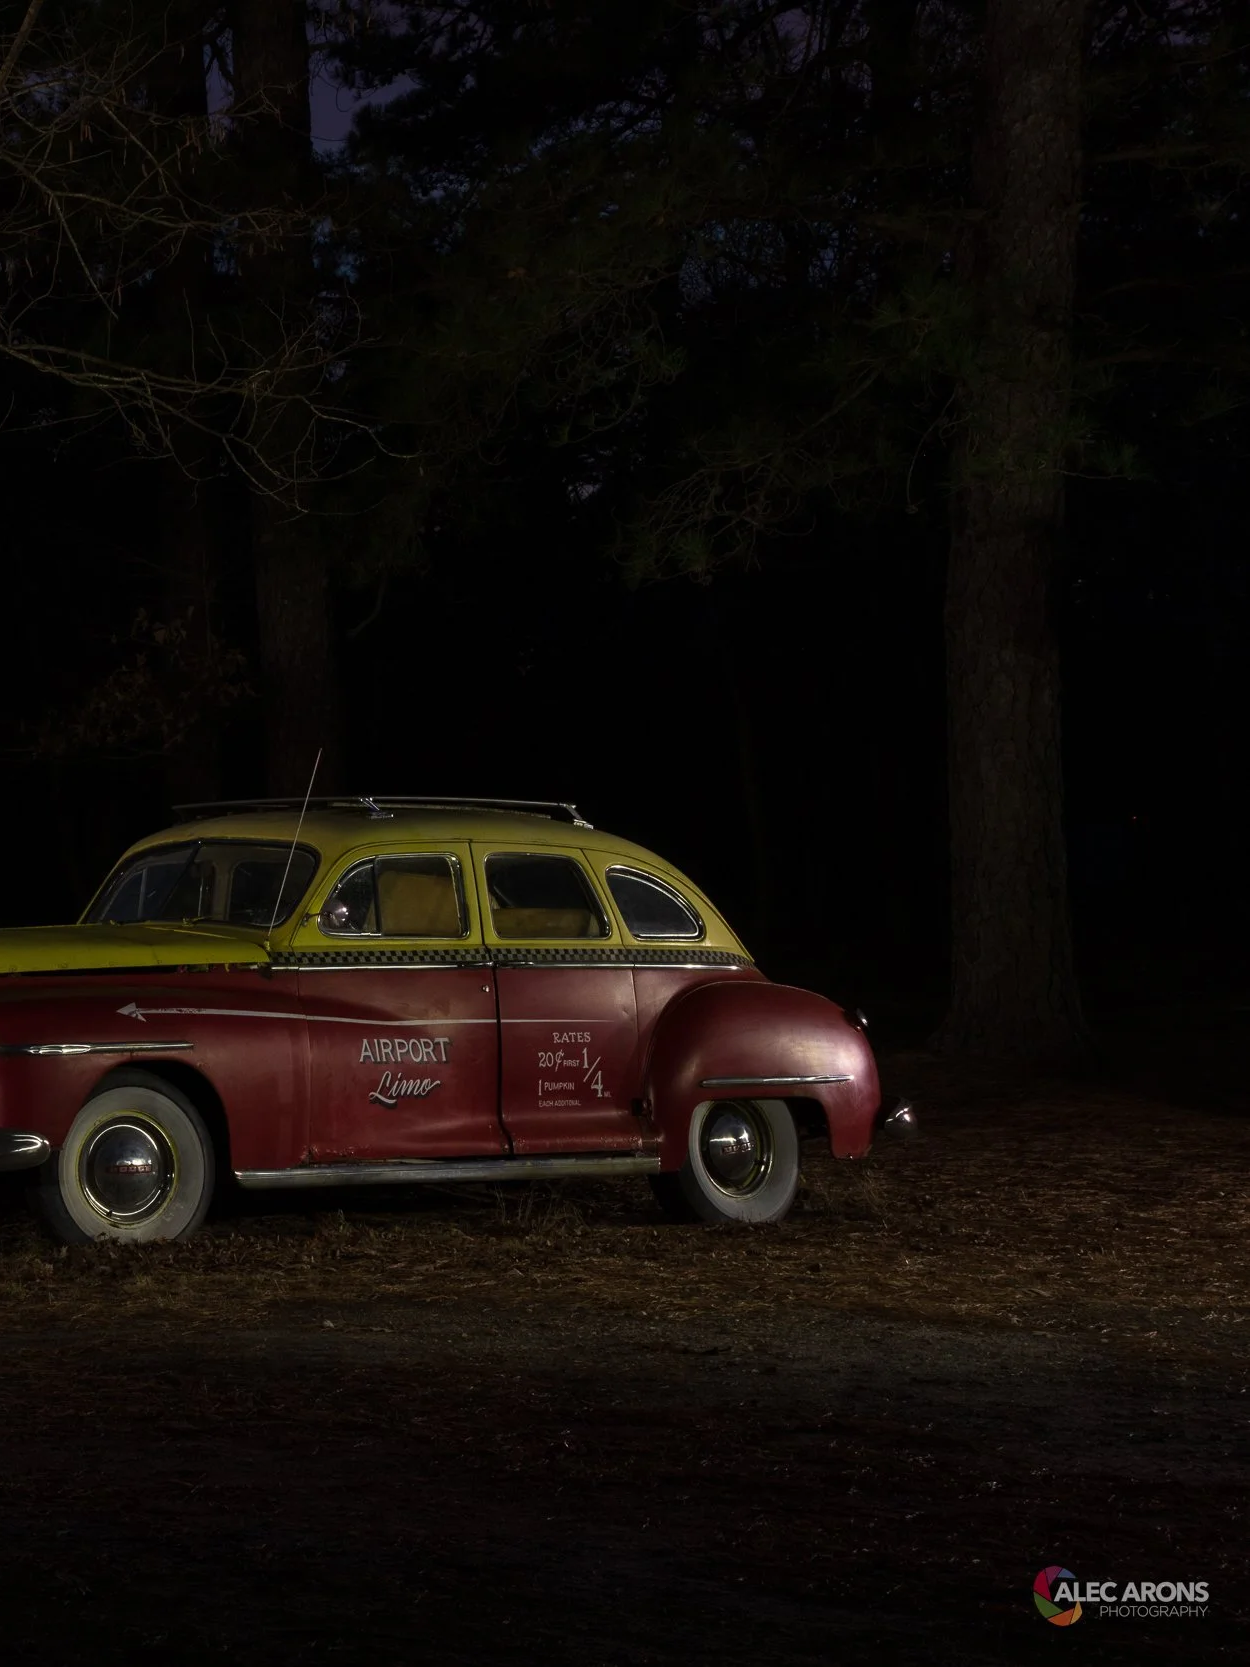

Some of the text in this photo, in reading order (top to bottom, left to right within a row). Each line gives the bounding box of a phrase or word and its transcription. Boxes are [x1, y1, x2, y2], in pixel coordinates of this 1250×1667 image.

[552, 1032, 591, 1043] RATES
[359, 1037, 450, 1062] AIRPORT
[368, 1071, 441, 1106] Limo
[544, 1082, 575, 1091] PUMPKIN
